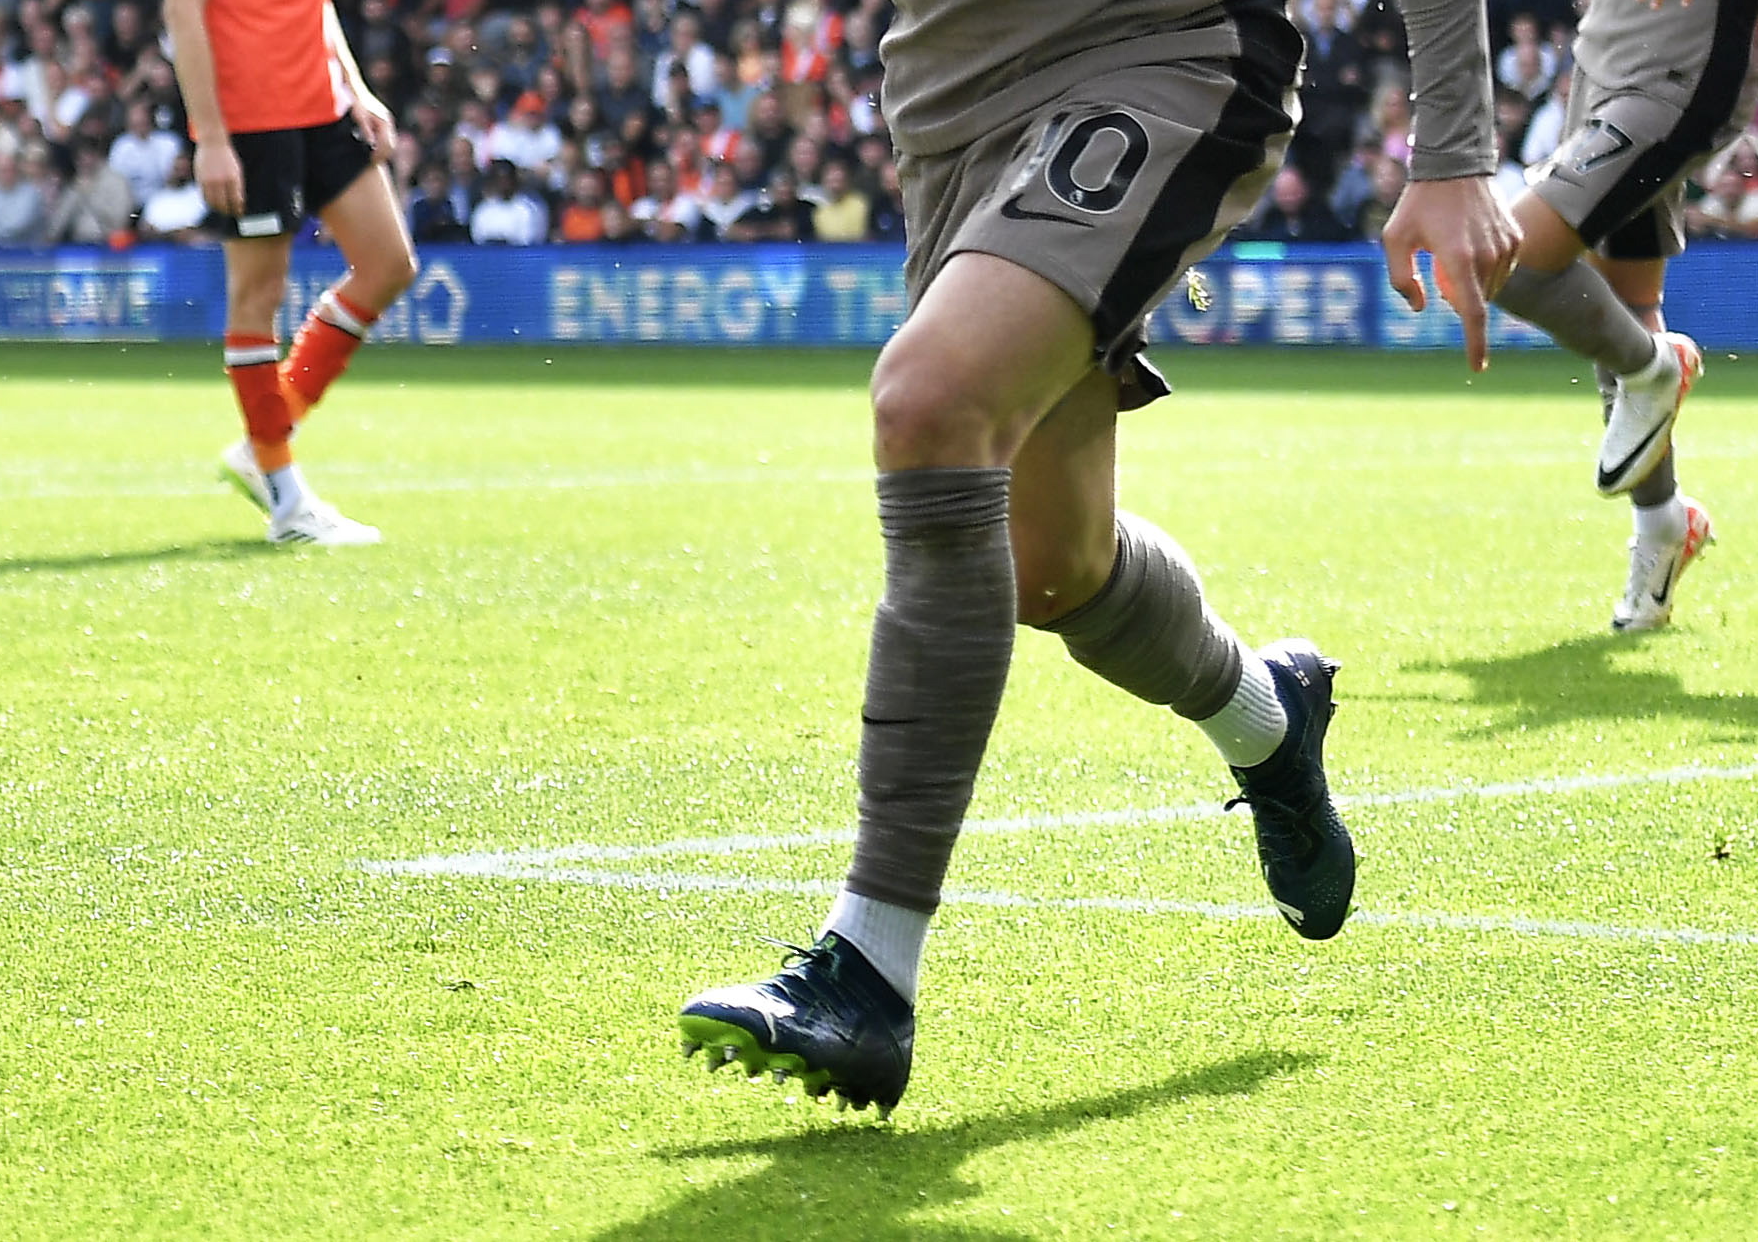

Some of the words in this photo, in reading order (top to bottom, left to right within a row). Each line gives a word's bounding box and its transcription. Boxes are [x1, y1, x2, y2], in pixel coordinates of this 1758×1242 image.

[1573, 118, 1637, 176] 7
[550, 267, 808, 340] ENERGY
[820, 267, 907, 340] TH
